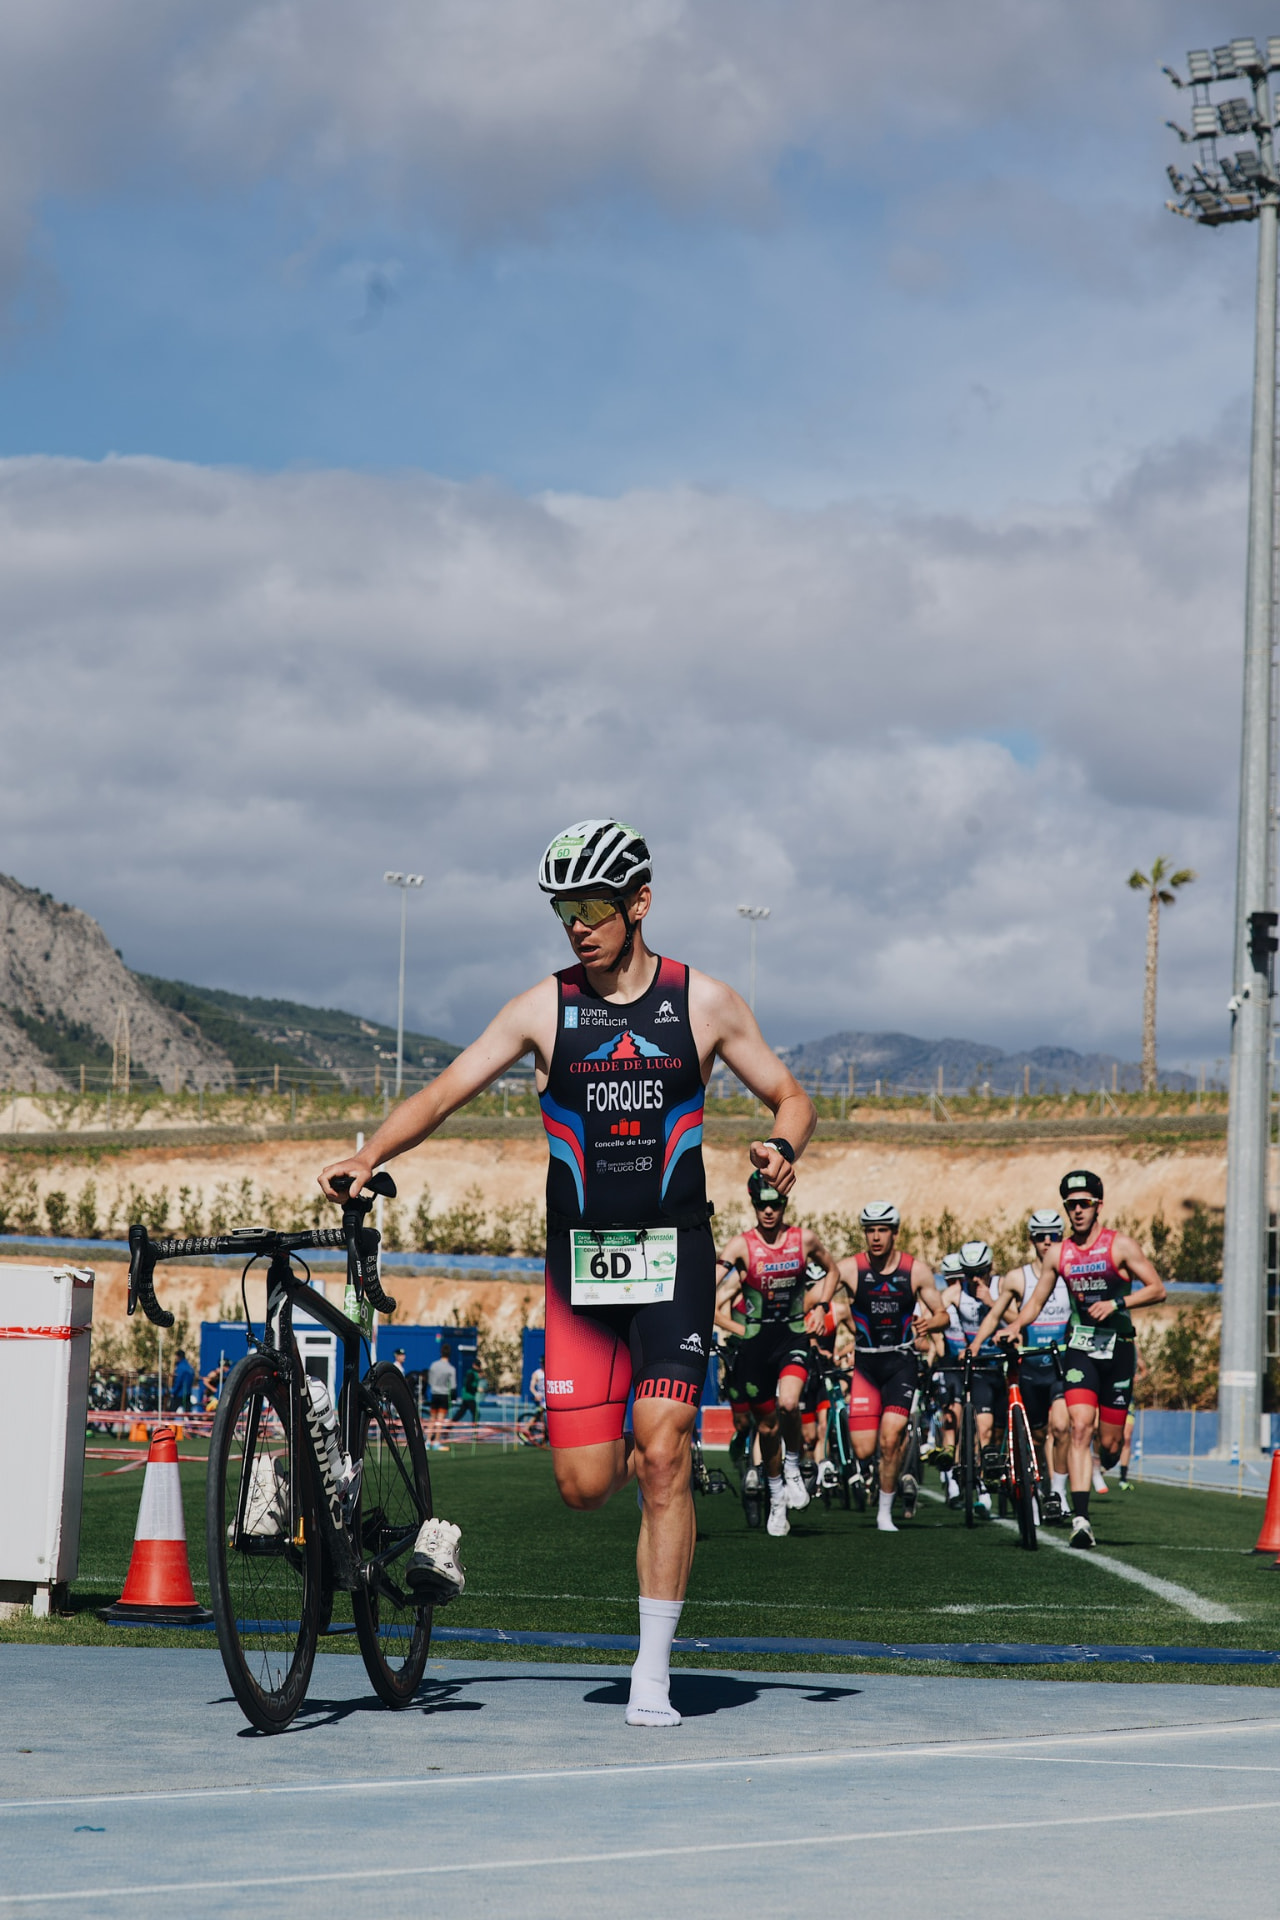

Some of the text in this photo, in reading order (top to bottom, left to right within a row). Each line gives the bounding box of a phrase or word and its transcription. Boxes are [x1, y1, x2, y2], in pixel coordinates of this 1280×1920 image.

[580, 1007, 608, 1018] XUNTA
[580, 1017, 628, 1027] DE GALICIA
[569, 1057, 682, 1073] CIDADE DE LUGO
[586, 1079, 664, 1113] FORQUES
[594, 1137, 657, 1149] Concello de Lugo
[590, 1252, 632, 1279] 6D
[764, 1260, 799, 1272] SALTOKI
[1071, 1261, 1106, 1273] SALTOKI
